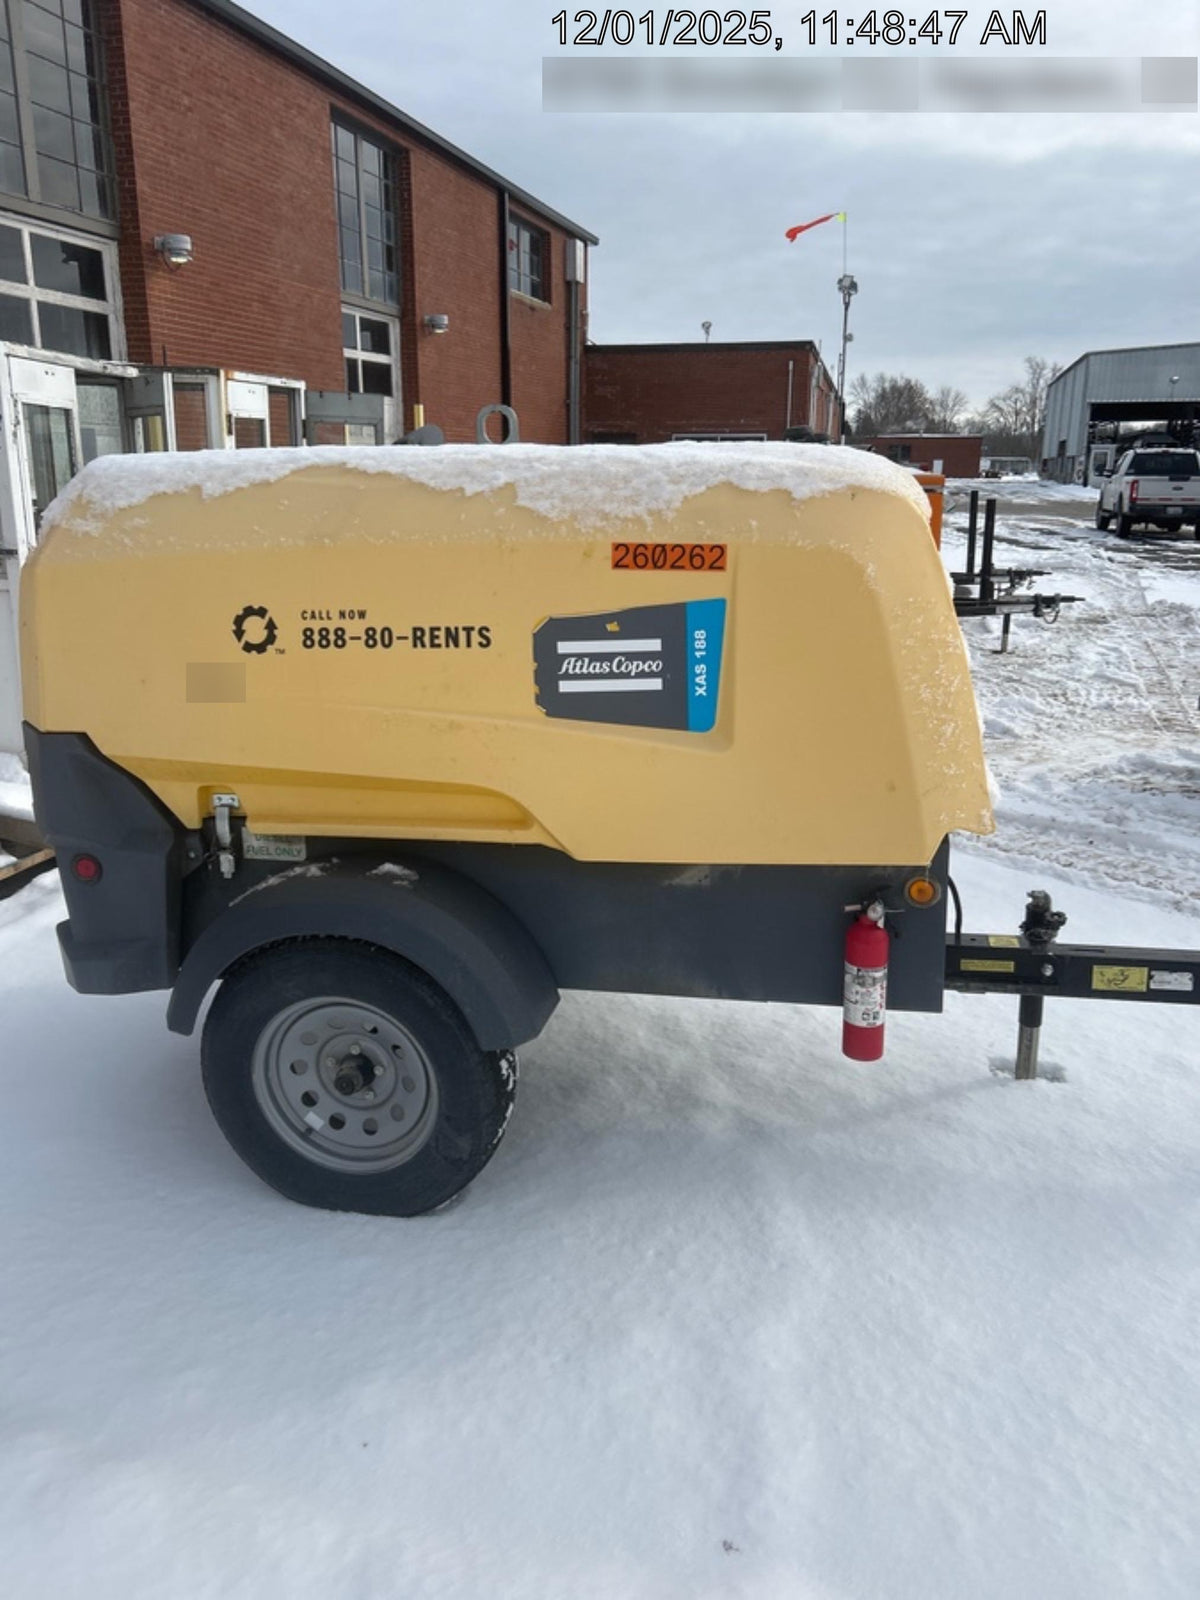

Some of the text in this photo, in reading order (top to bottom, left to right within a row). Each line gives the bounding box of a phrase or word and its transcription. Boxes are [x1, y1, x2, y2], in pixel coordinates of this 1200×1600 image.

[613, 543, 726, 570] 260262
[301, 609, 368, 621] CALL NOW
[301, 625, 492, 650] 888-80-RENTS
[558, 655, 663, 677] Atlas Copco
[694, 629, 707, 697] XAS 188
[246, 844, 303, 857] FUEL ONLY
